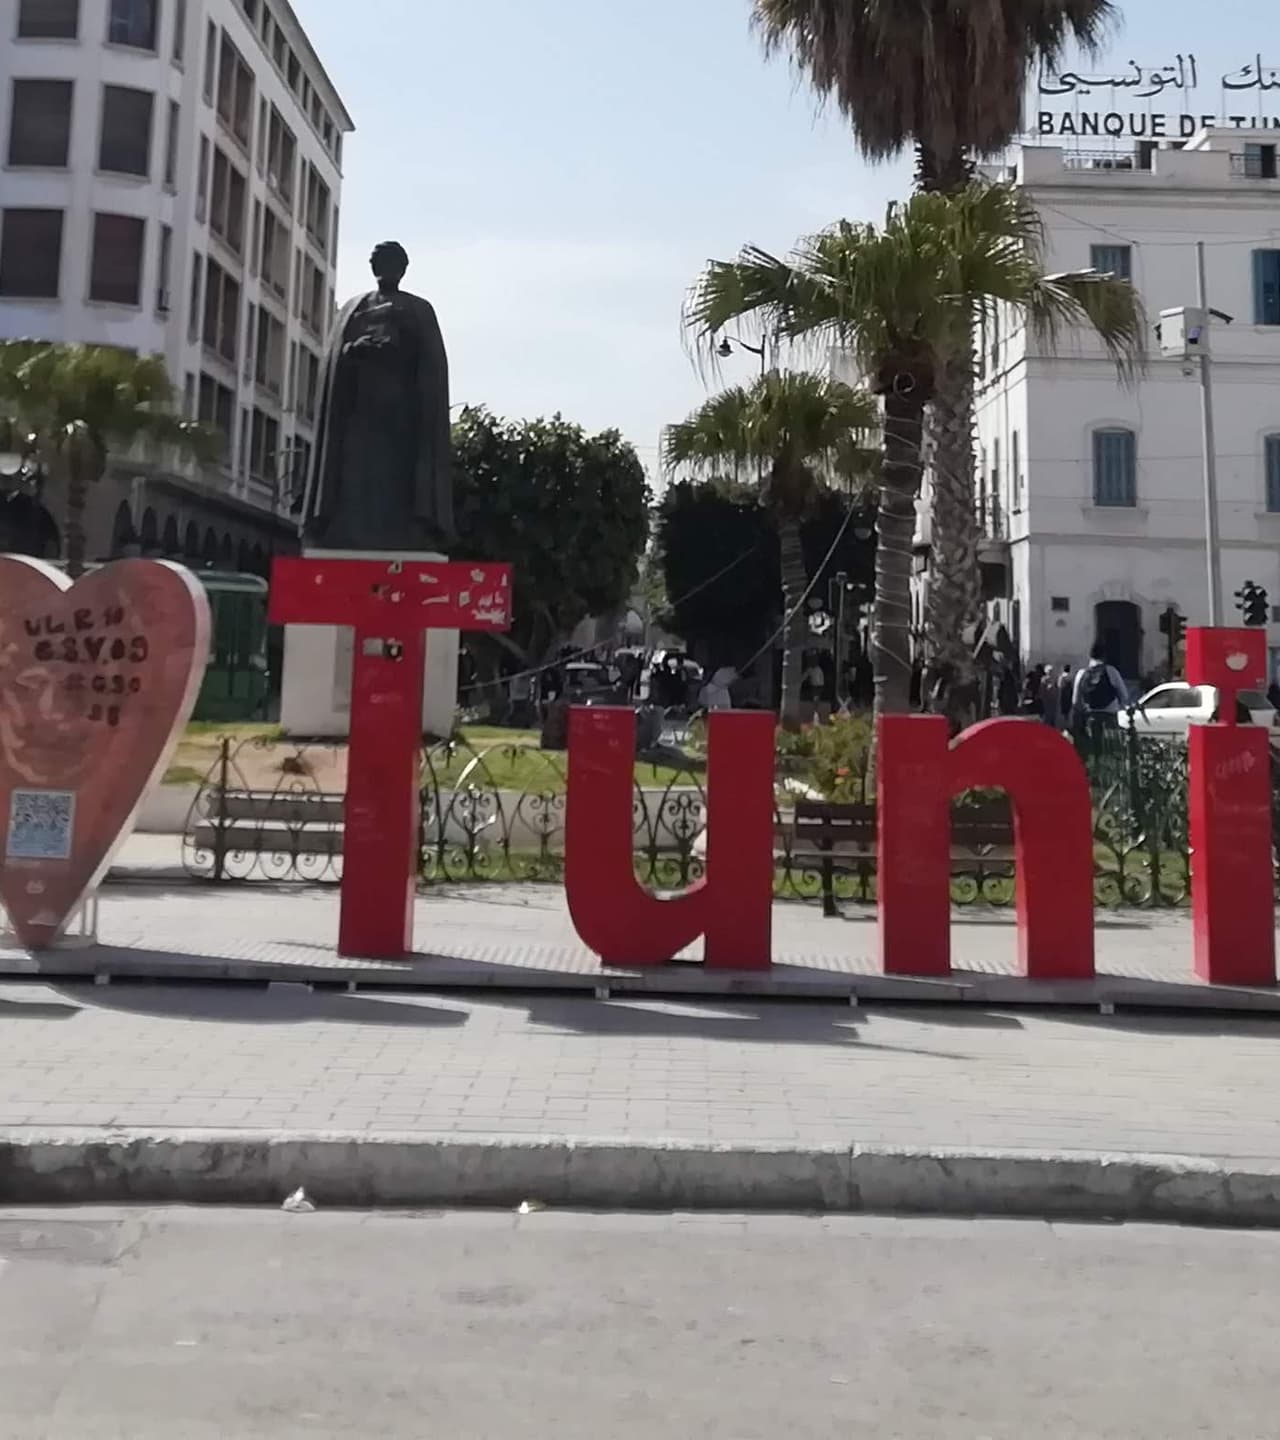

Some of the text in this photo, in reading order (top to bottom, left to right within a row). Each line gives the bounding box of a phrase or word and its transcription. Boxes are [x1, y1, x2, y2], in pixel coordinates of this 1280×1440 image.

[1038, 53, 1198, 97] التونسي
[1038, 111, 1166, 137] BANQUE
[1179, 114, 1216, 137] DE
